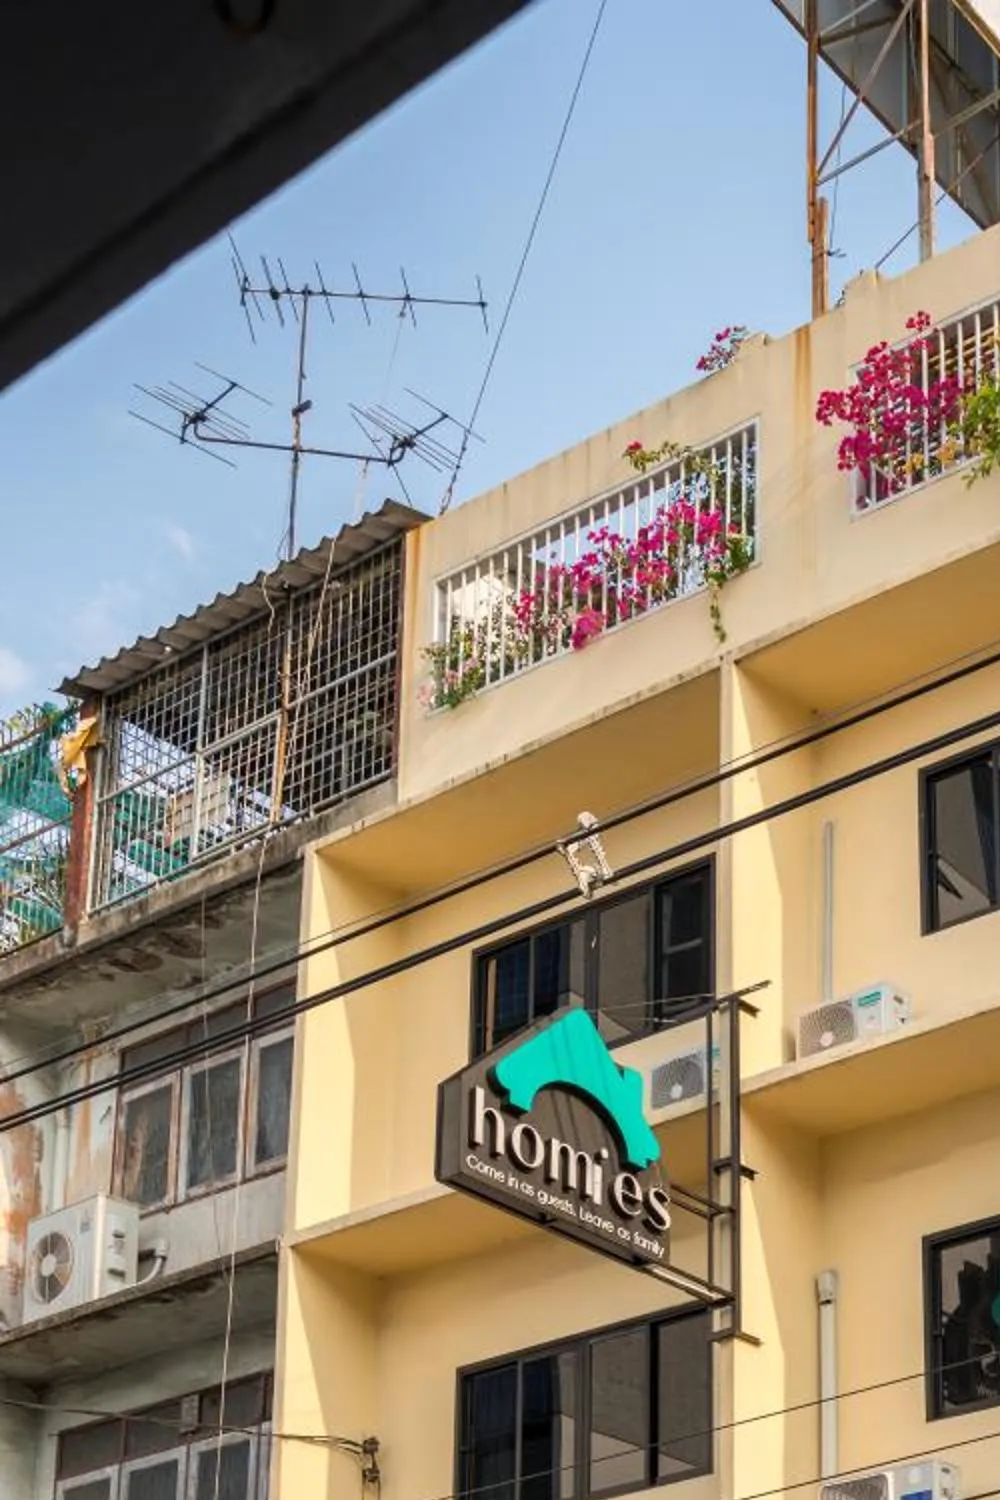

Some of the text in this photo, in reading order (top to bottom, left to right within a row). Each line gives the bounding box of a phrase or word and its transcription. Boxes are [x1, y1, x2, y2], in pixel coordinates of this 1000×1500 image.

[465, 1153, 505, 1185] Come
[507, 1169, 521, 1190] in
[520, 1180, 535, 1197] as
[579, 1205, 614, 1233] Leave
[617, 1225, 631, 1240] as
[633, 1230, 665, 1258] family
[468, 1085, 672, 1232] homies
